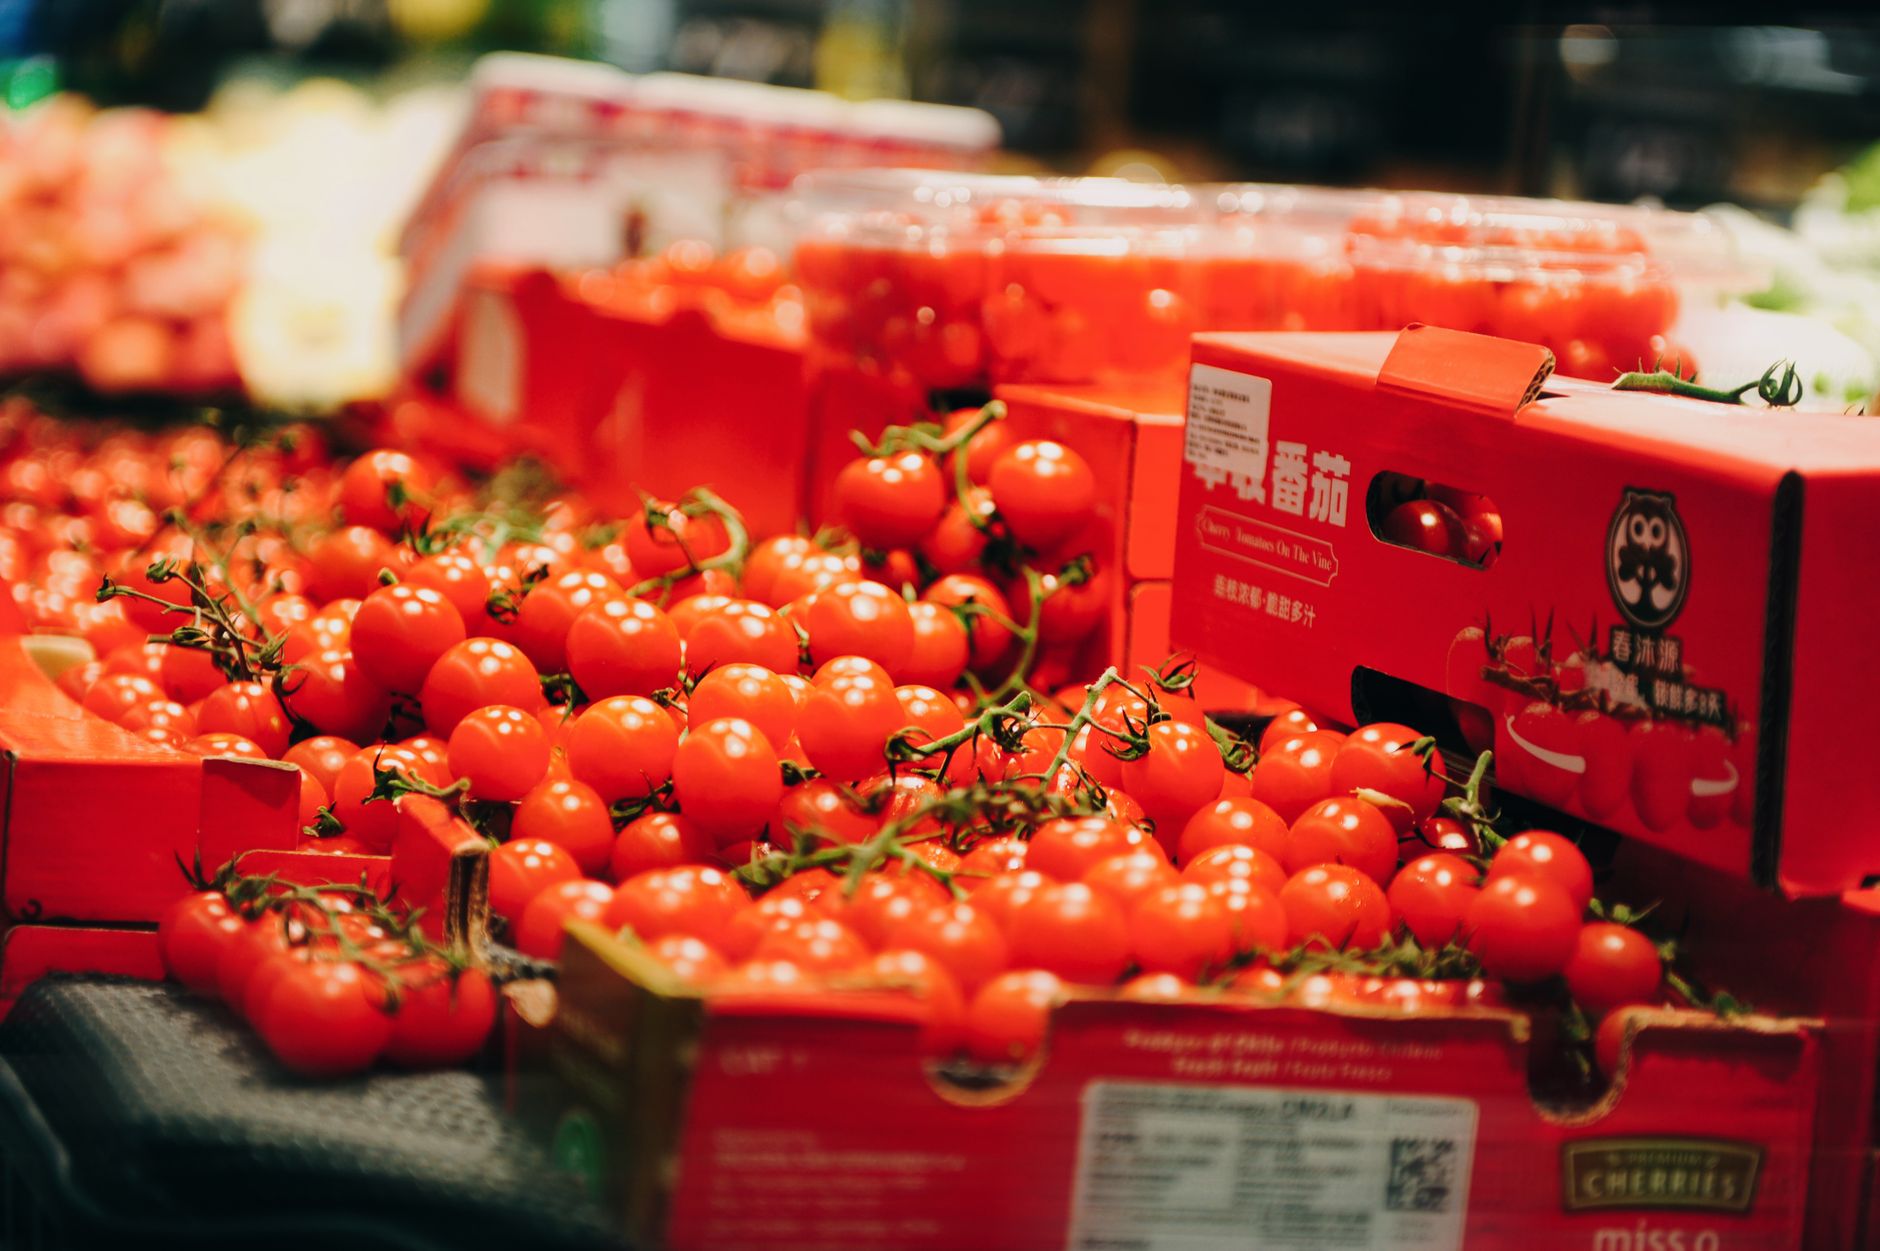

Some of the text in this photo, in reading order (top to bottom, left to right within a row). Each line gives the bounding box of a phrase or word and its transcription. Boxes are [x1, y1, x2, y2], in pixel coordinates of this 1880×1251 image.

[1202, 517, 1332, 571] Cherry Tomatoes On The Vine
[1582, 1169, 1737, 1199] CHERRIES
